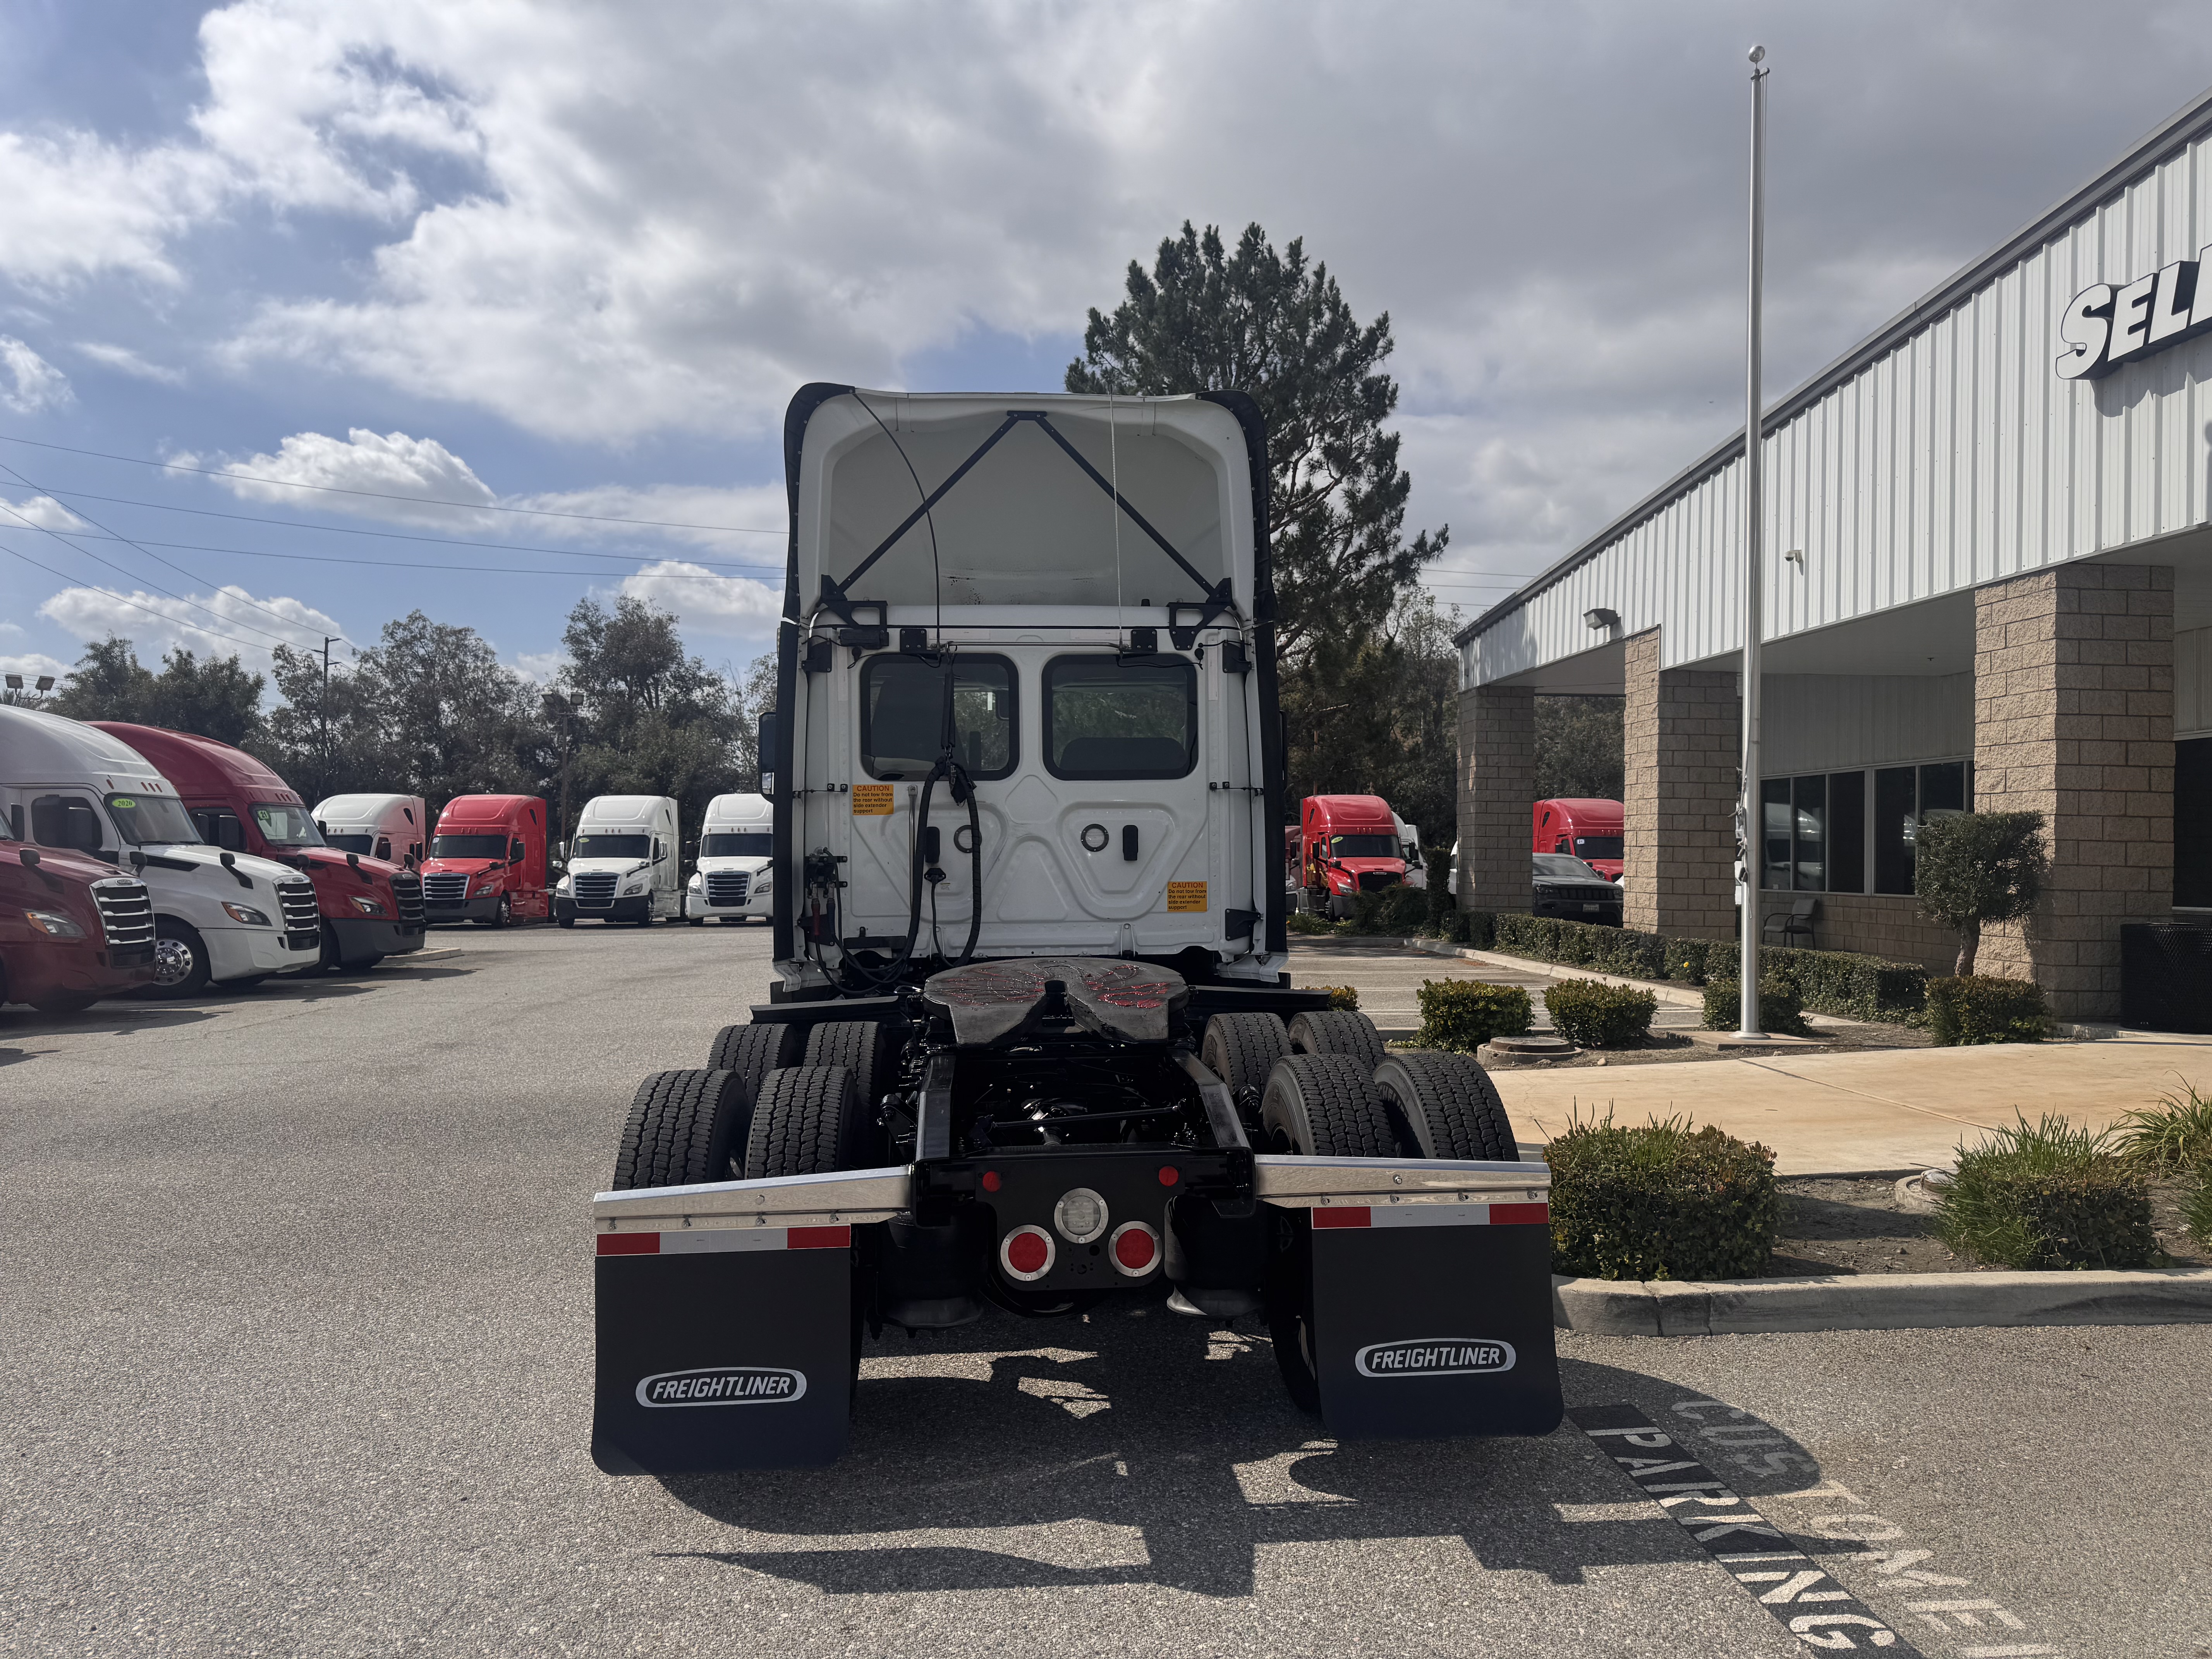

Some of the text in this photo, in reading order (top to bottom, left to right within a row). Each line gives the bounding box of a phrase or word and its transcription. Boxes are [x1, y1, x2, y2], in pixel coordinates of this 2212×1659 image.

[2056, 243, 2212, 380] SEL
[652, 1376, 790, 1399] FREIGHTLINER
[1372, 1347, 1500, 1369] FREIGHTLINER
[1585, 1427, 1895, 1649] PARKING
